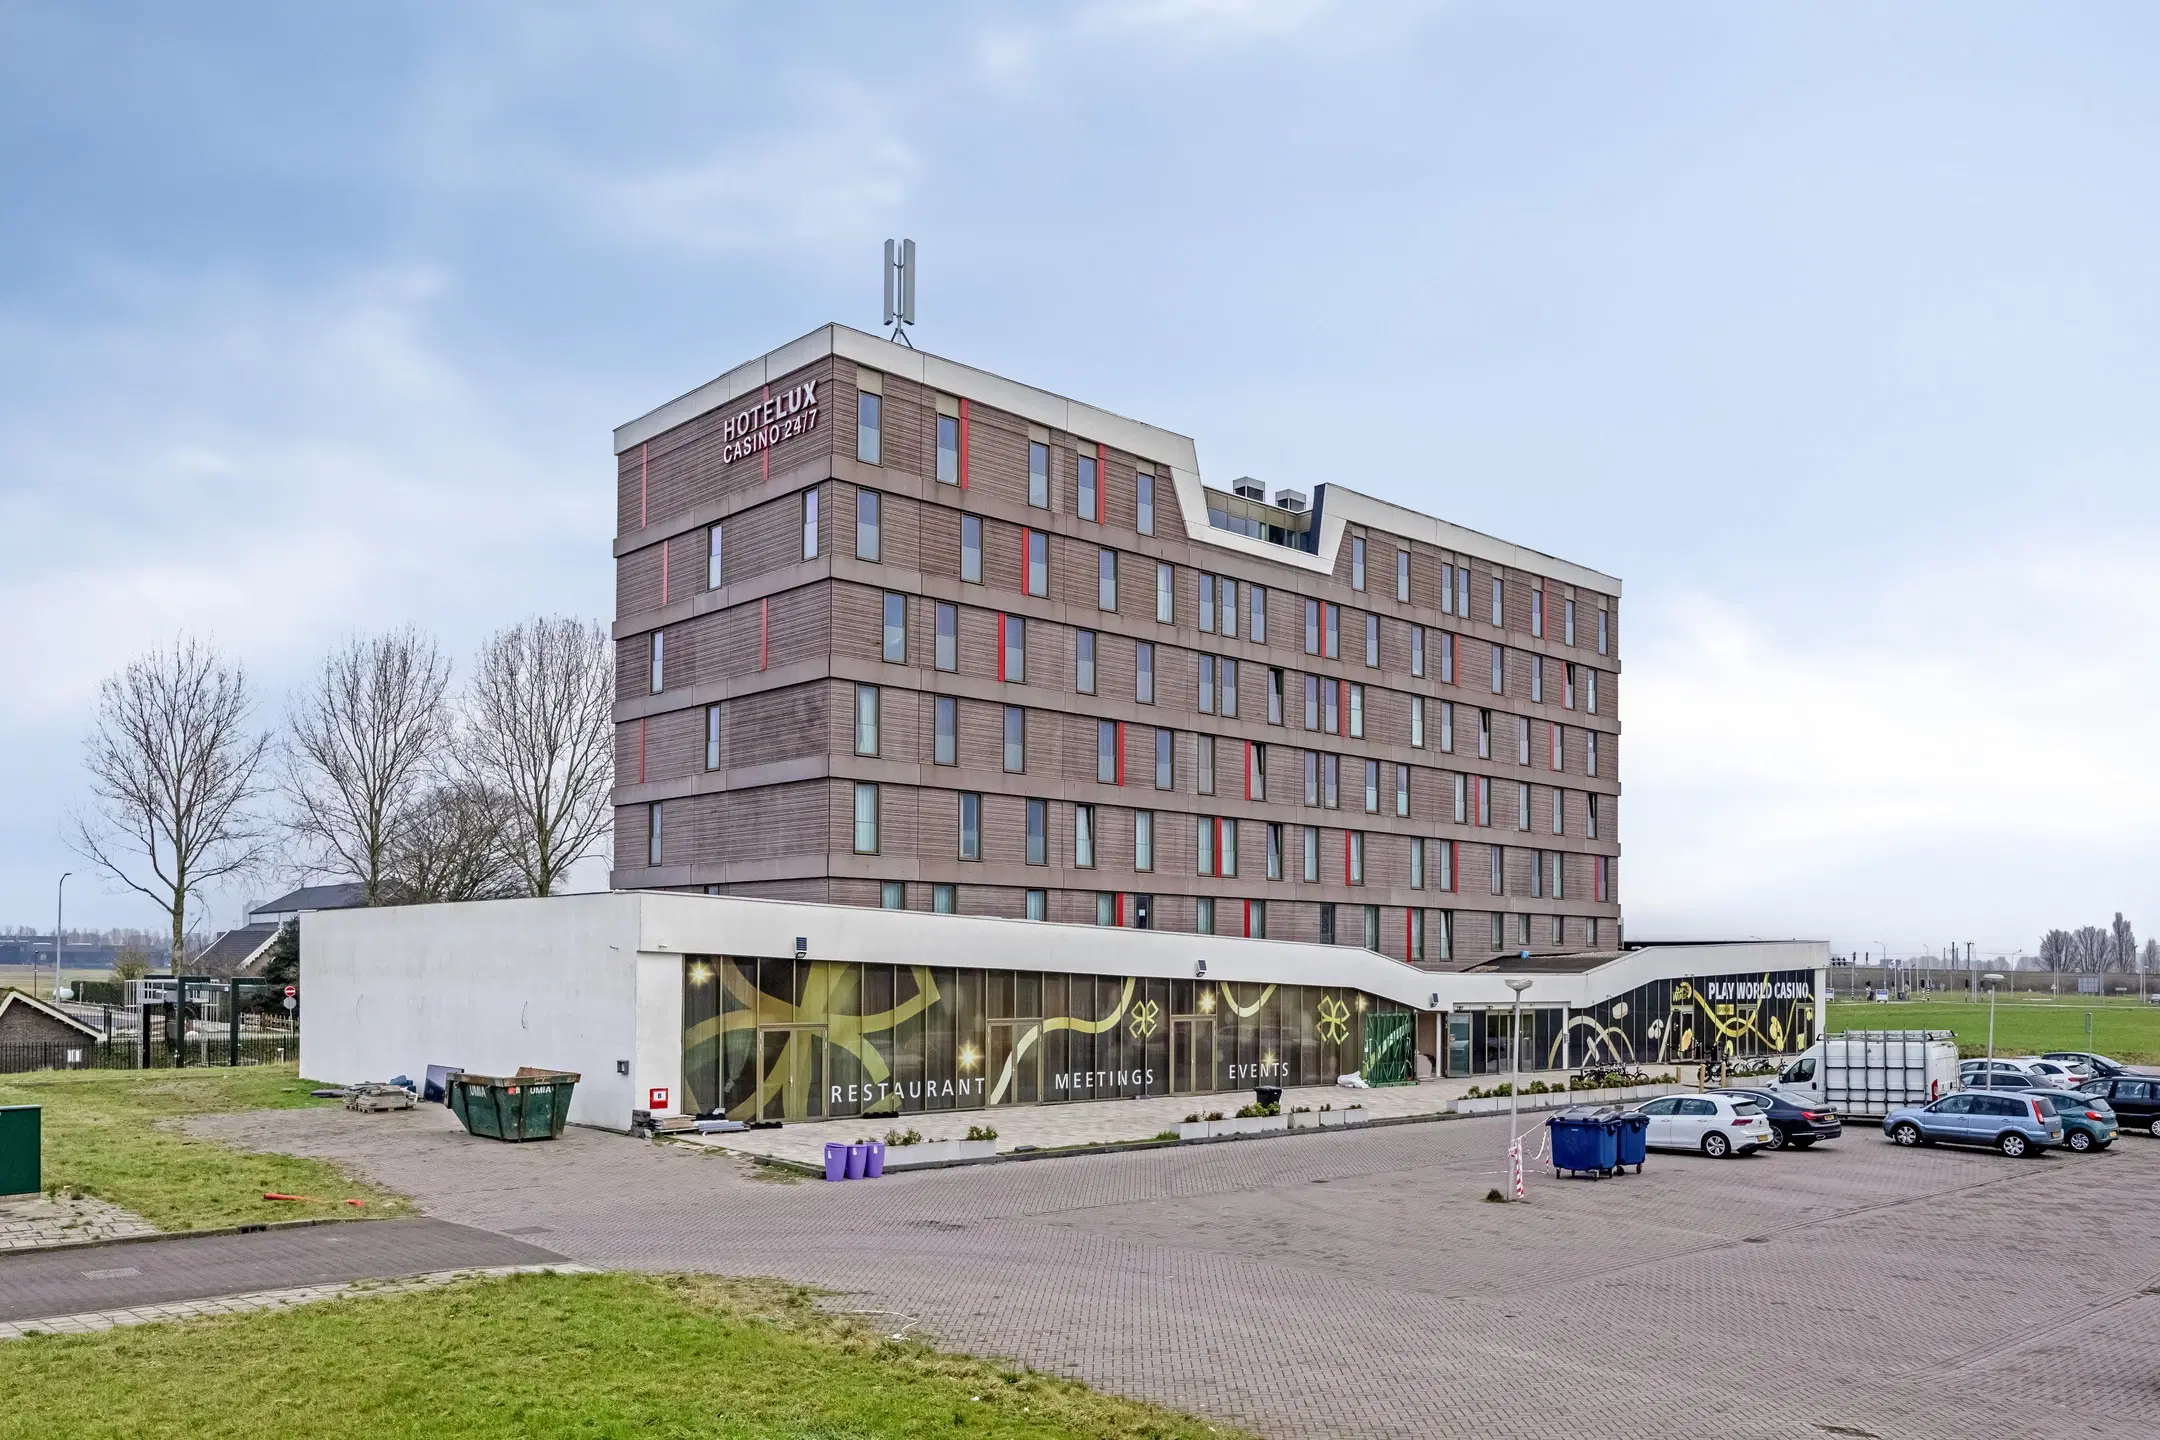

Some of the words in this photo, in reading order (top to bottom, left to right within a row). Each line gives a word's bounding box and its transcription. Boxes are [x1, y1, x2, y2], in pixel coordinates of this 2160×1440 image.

[724, 380, 818, 442] HOTELUX
[723, 424, 780, 464] CASINO
[784, 408, 818, 439] 24/7
[1708, 982, 1735, 1000] PLAY
[1736, 982, 1773, 1000] WORLD
[1774, 982, 1809, 999] CASINO
[1055, 1069, 1154, 1090] MEETINGS
[1229, 1062, 1289, 1079] EVENTS
[831, 1077, 985, 1103] RESTAURANT
